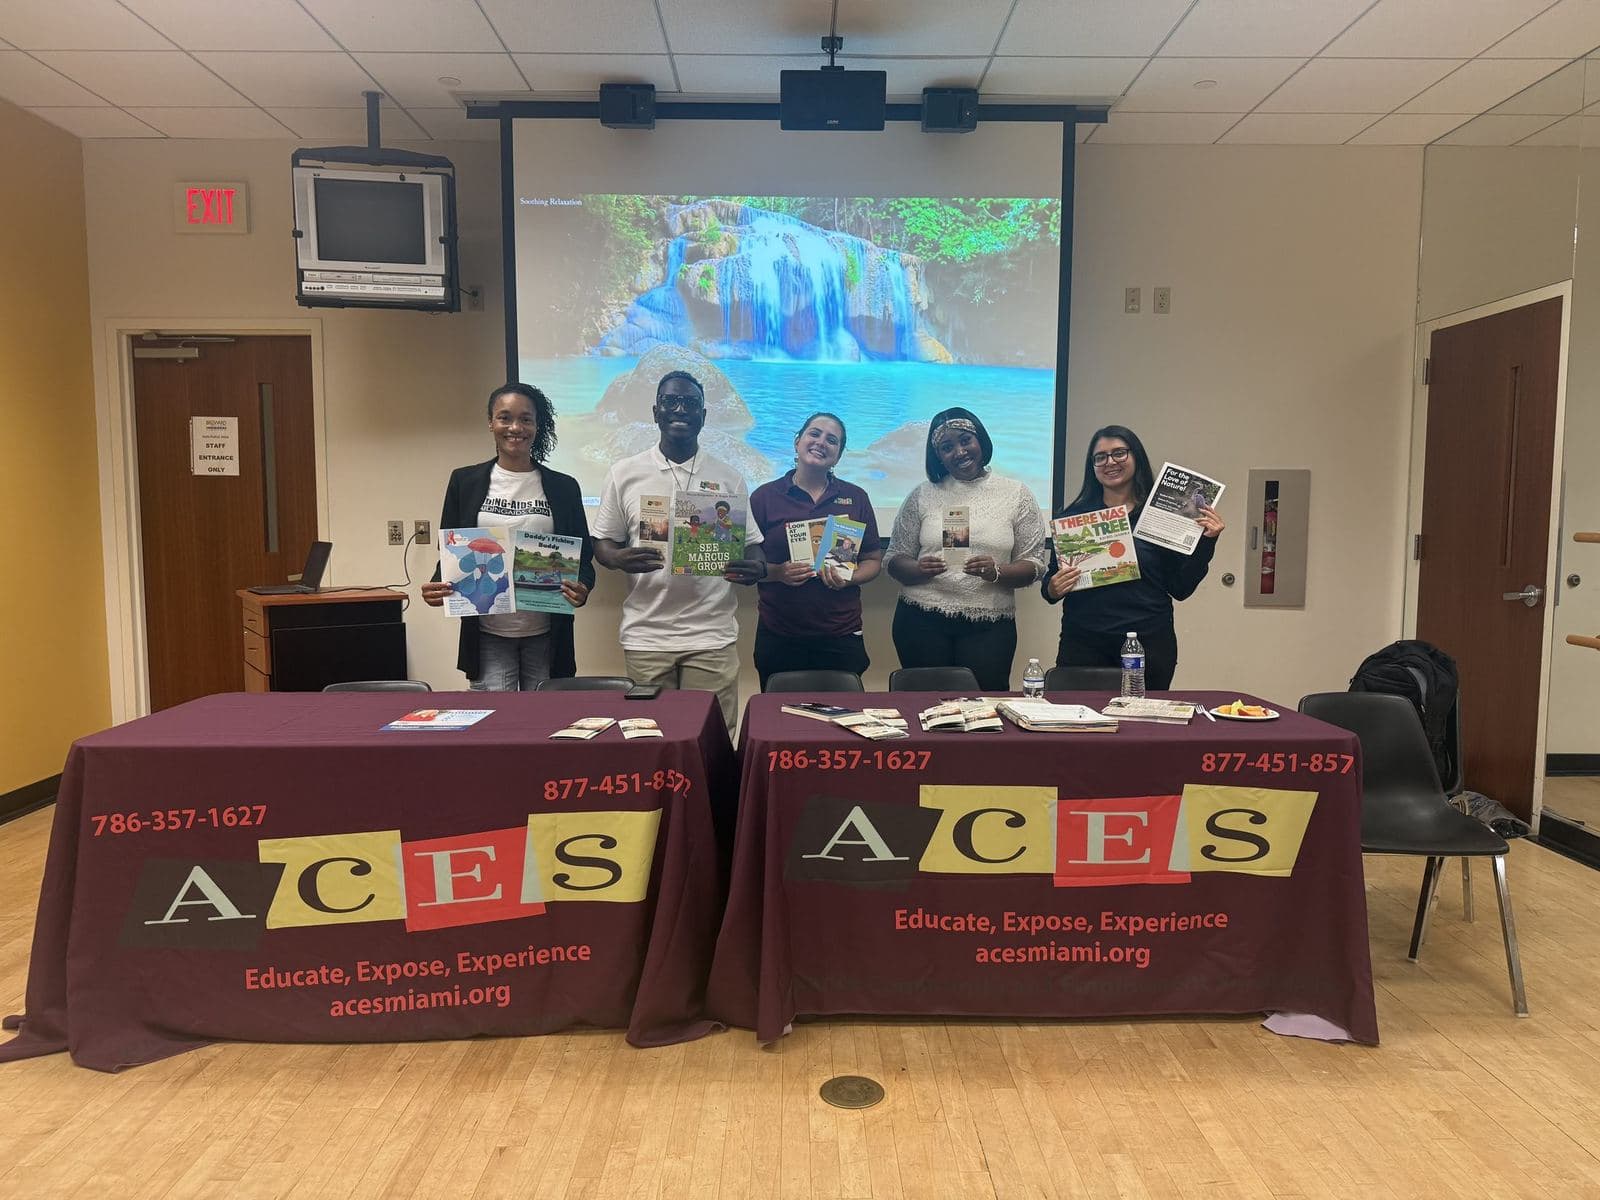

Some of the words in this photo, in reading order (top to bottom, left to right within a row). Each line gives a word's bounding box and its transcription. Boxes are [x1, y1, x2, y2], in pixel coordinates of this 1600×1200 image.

[186, 188, 237, 224] EXIT
[520, 197, 548, 207] Soothing
[549, 197, 583, 206] Relaxation
[1163, 474, 1179, 483] Love
[1166, 468, 1178, 477] For
[1178, 472, 1190, 480] the
[1161, 479, 1187, 492] Nature!
[1058, 513, 1098, 530] THERE
[1098, 507, 1126, 521] WAS
[1081, 525, 1094, 538] A
[1091, 518, 1130, 537] TREE
[524, 532, 551, 541] Daddy's
[538, 541, 560, 550] Buddy
[688, 552, 730, 562] MARCUS
[699, 543, 719, 552] SEE
[697, 561, 727, 571] GROW
[768, 750, 932, 772] 786-357-1627
[91, 804, 268, 837] 786-357-1627
[802, 805, 1271, 863] ACES
[144, 833, 623, 925] ACES
[895, 908, 998, 936] Educate,
[1003, 910, 1094, 936] Expose,
[1100, 910, 1229, 936] Experience
[975, 940, 1151, 969] acesmiami.org
[245, 965, 351, 990] Educate,
[356, 957, 451, 985] Expose,
[456, 944, 592, 976] Experience
[330, 983, 511, 1017] acesmiami.org
